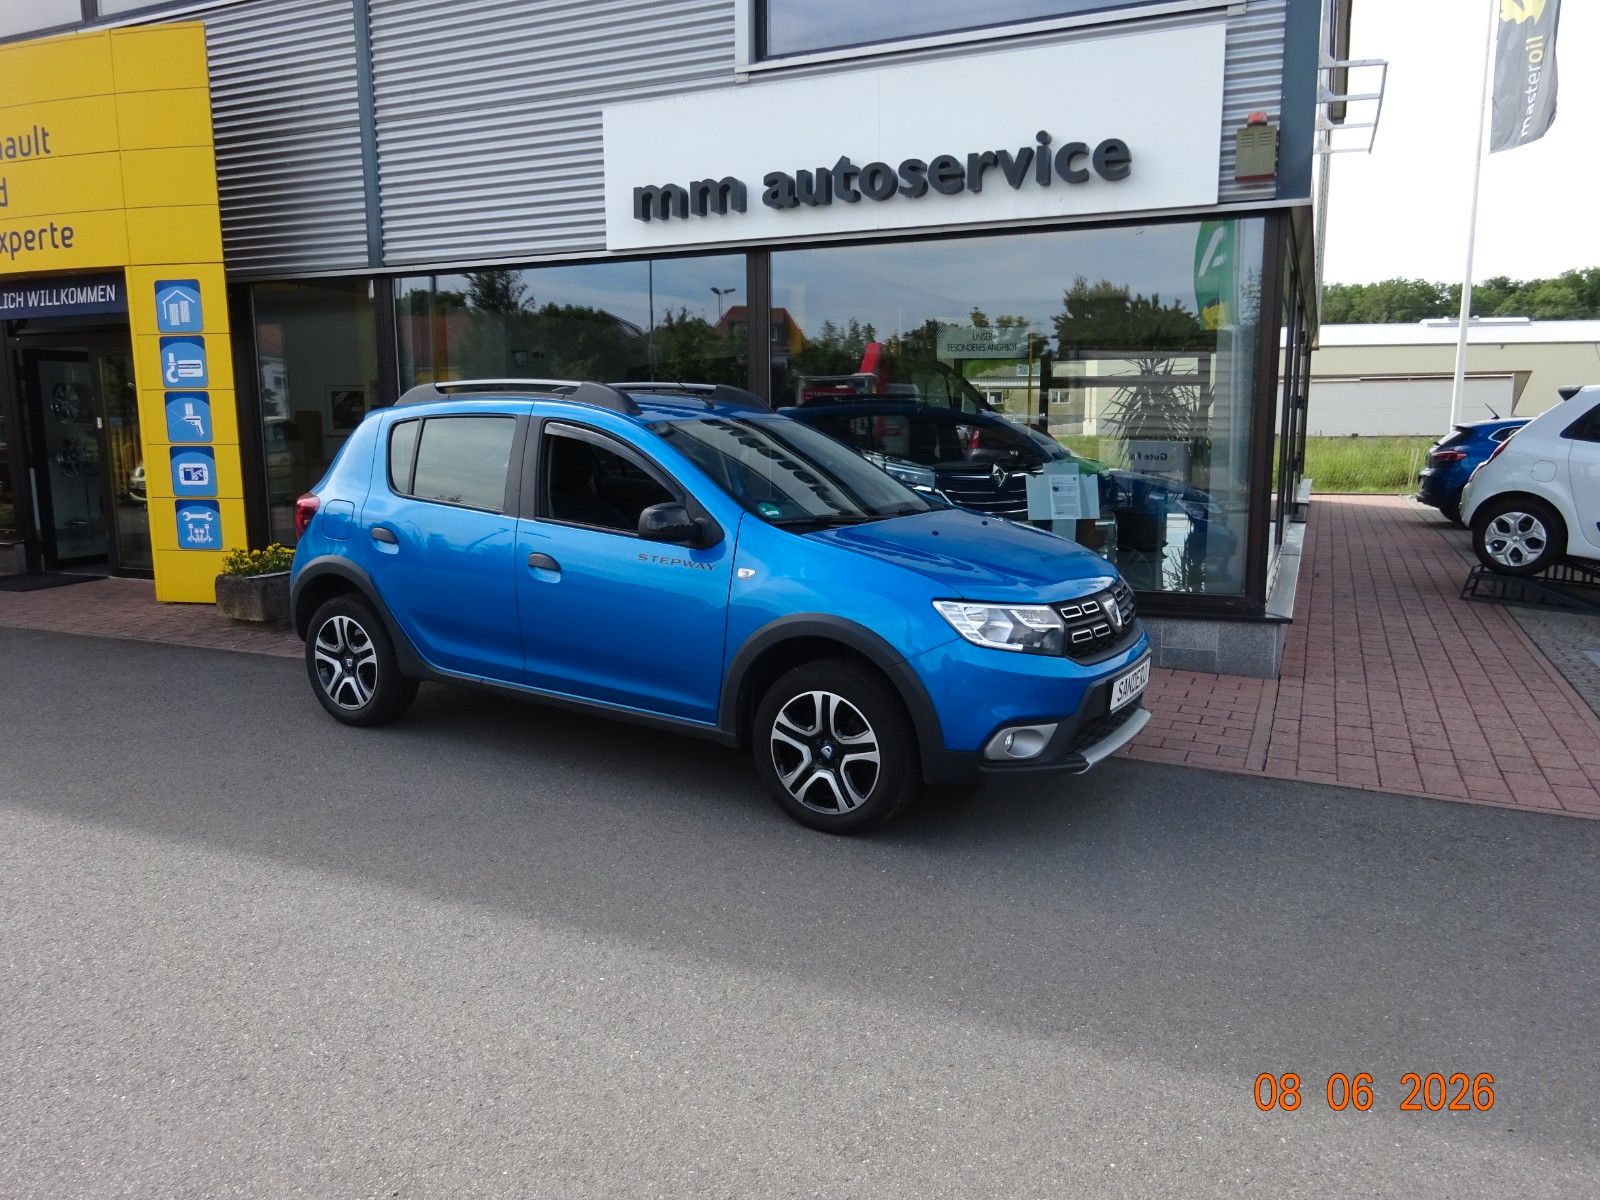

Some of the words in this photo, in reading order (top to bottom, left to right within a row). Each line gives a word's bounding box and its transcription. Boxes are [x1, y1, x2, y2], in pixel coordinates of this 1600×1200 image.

[1521, 35, 1544, 138] masteroil
[0, 125, 51, 161] ault
[633, 176, 748, 222] mm
[761, 130, 1133, 210] autoservice
[27, 284, 117, 307] WILLKOMMEN
[946, 343, 986, 352] BESONDERES
[987, 343, 1018, 352] ANGEBOT
[972, 332, 993, 341] UNSER
[637, 553, 716, 570] STEPWAY
